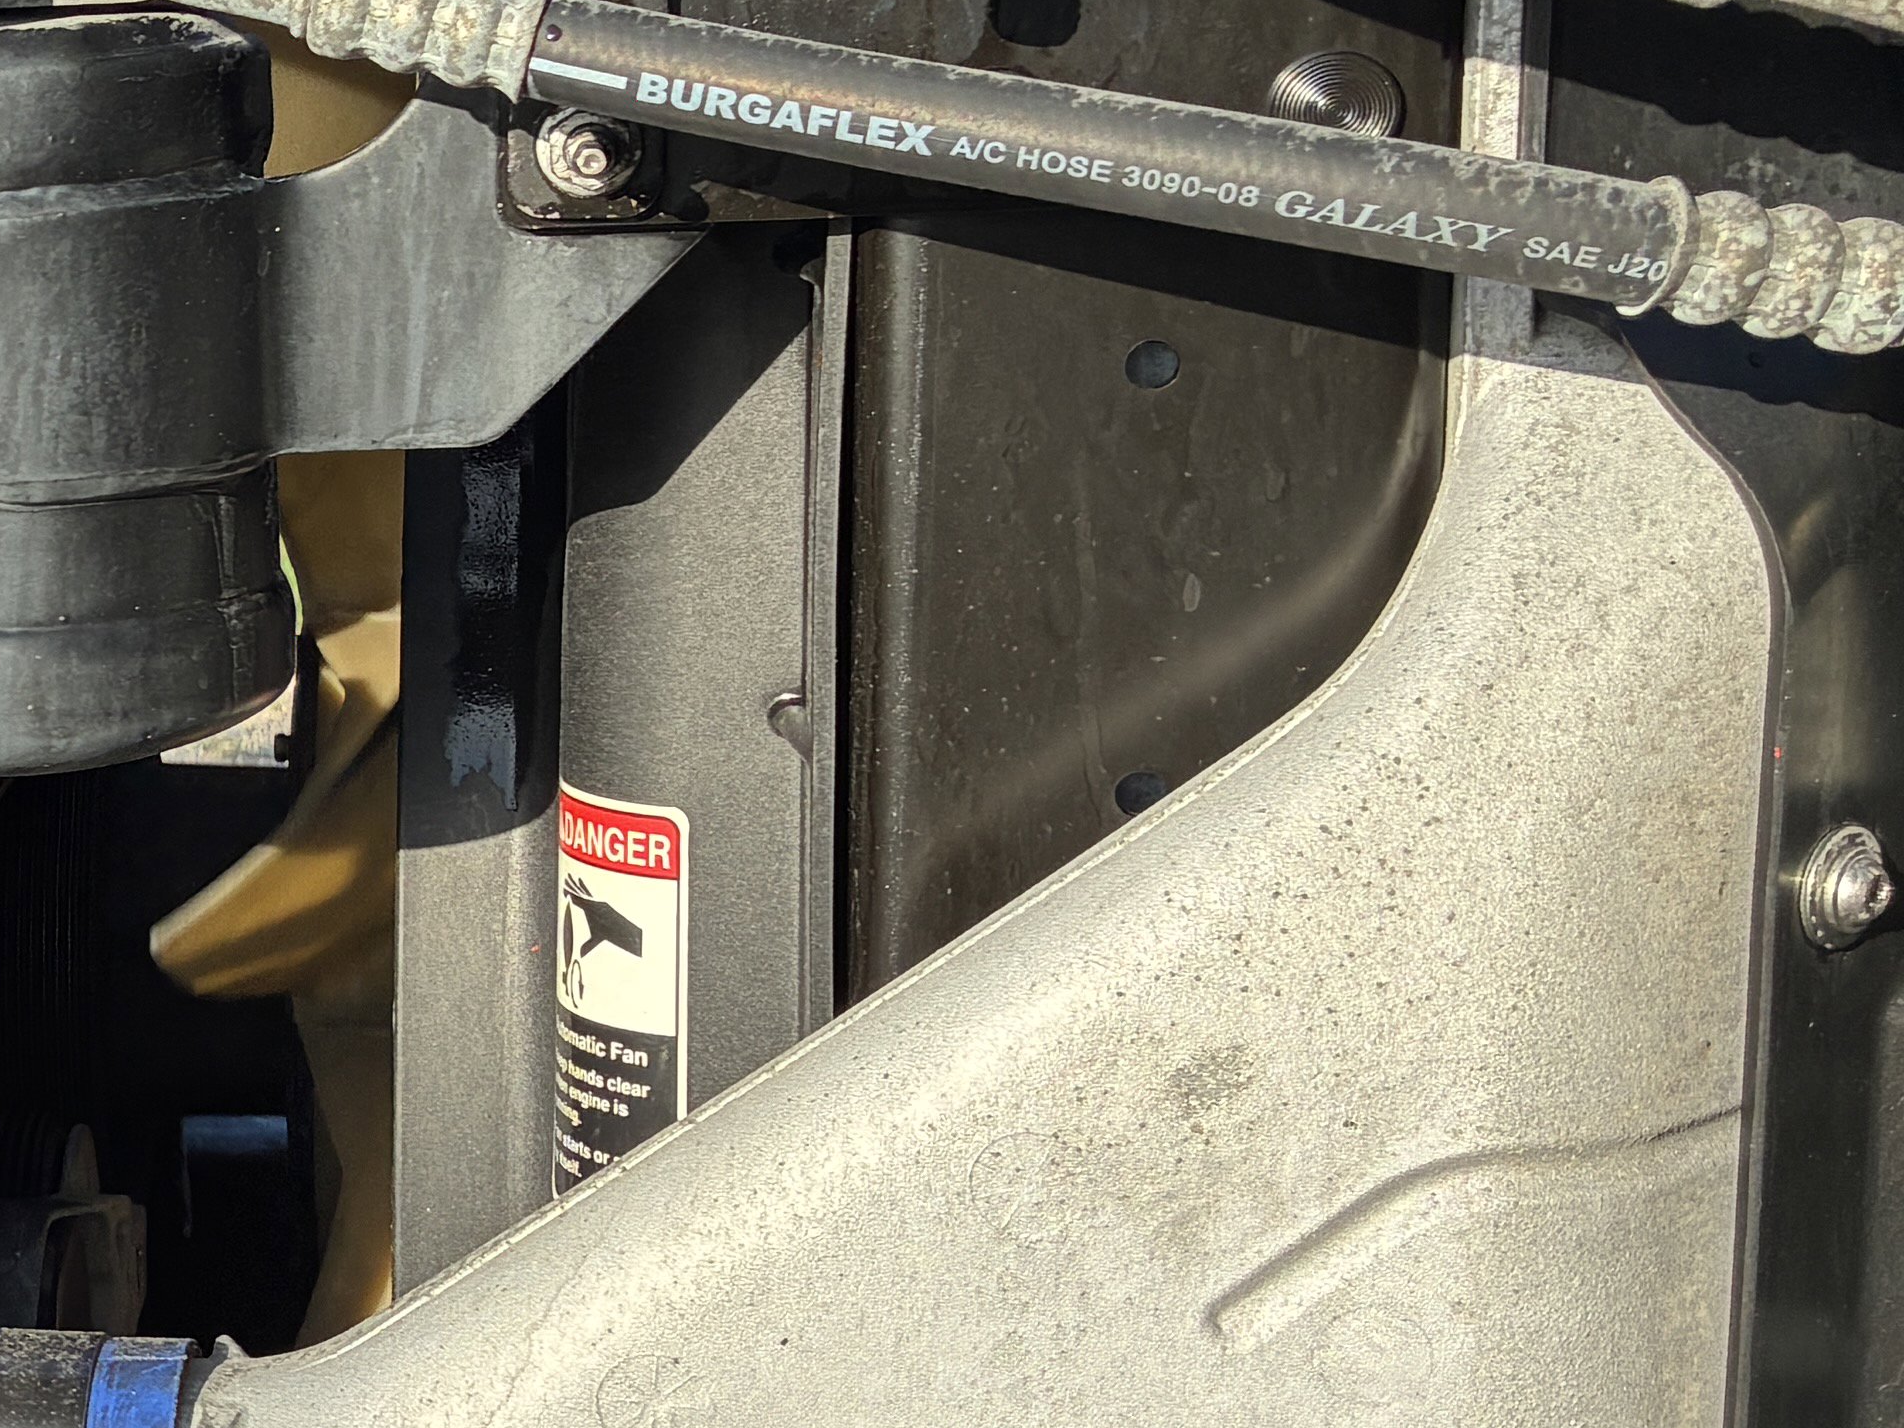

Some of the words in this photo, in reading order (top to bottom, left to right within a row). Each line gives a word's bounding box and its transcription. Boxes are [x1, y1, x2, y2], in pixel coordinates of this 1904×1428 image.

[634, 71, 937, 158] BURGAFLEX
[949, 135, 1009, 165] A/C
[1015, 146, 1114, 185] HOSE
[1119, 165, 1261, 209] 3090-08
[1273, 189, 1516, 253] GALAXY
[1521, 235, 1603, 270] SAE
[563, 814, 672, 870] DANGER
[610, 1041, 649, 1068] Fan
[568, 1059, 604, 1089] hands
[607, 1076, 652, 1099] clear
[569, 1083, 611, 1113] engine
[613, 1099, 630, 1118] is
[593, 1150, 611, 1166] or
